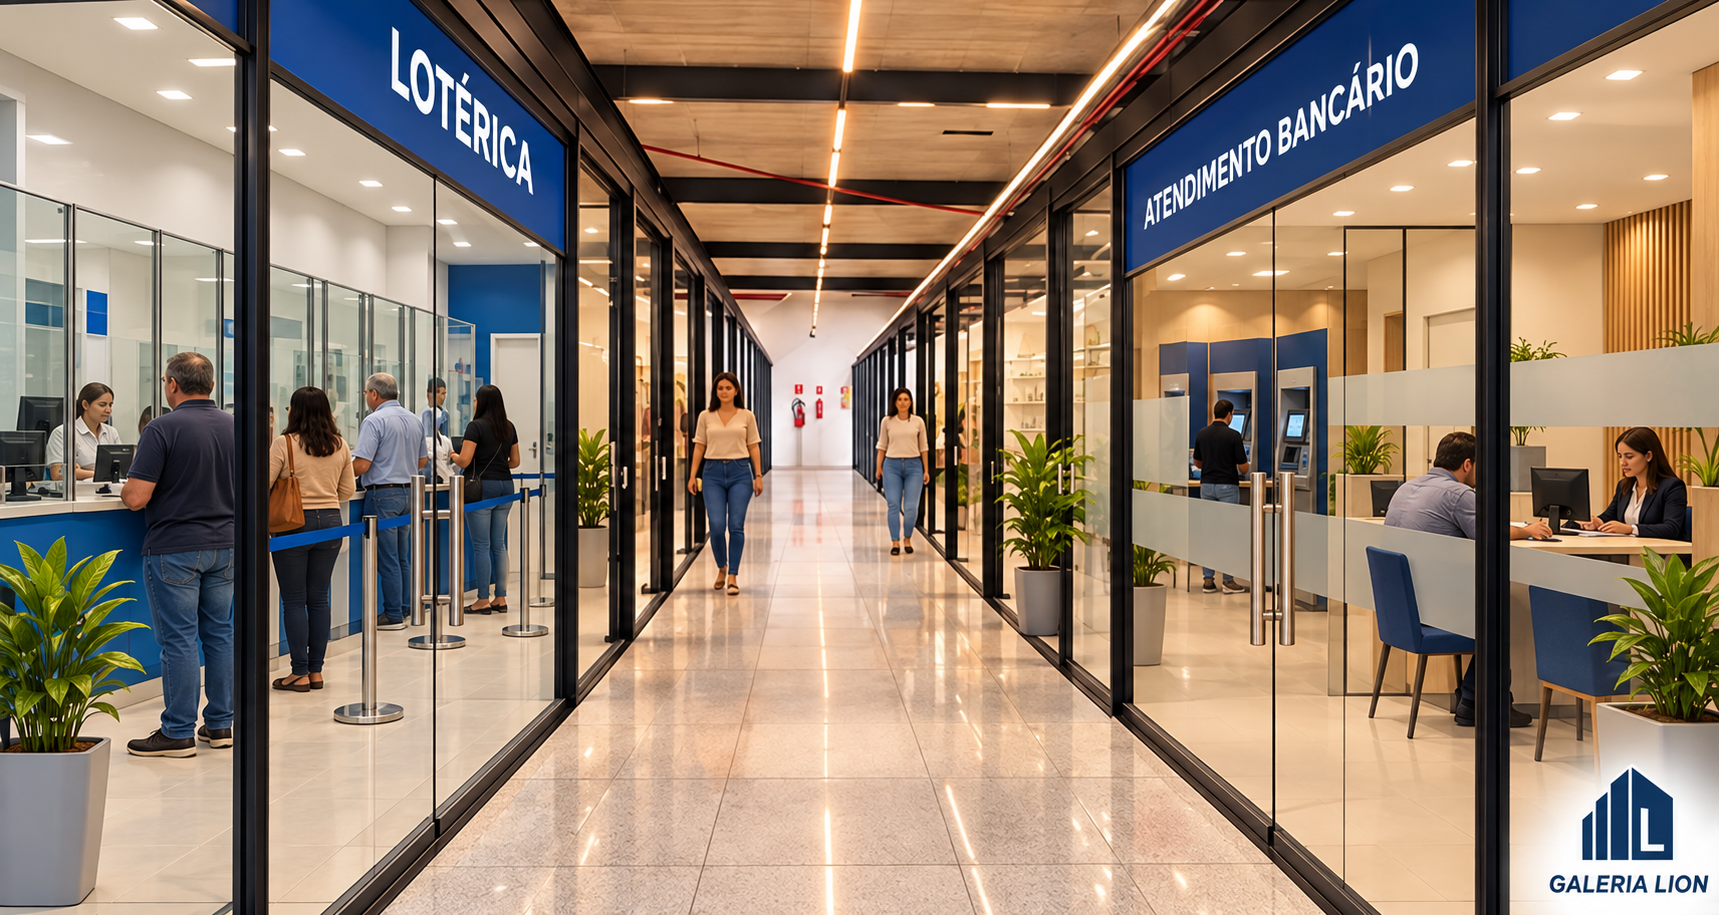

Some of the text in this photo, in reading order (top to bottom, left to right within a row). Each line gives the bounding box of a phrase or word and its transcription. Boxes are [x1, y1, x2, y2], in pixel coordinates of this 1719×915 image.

[391, 26, 534, 196] LOTÉRICA
[1143, 42, 1420, 230] ATENDIMENTO BANCÁRIO
